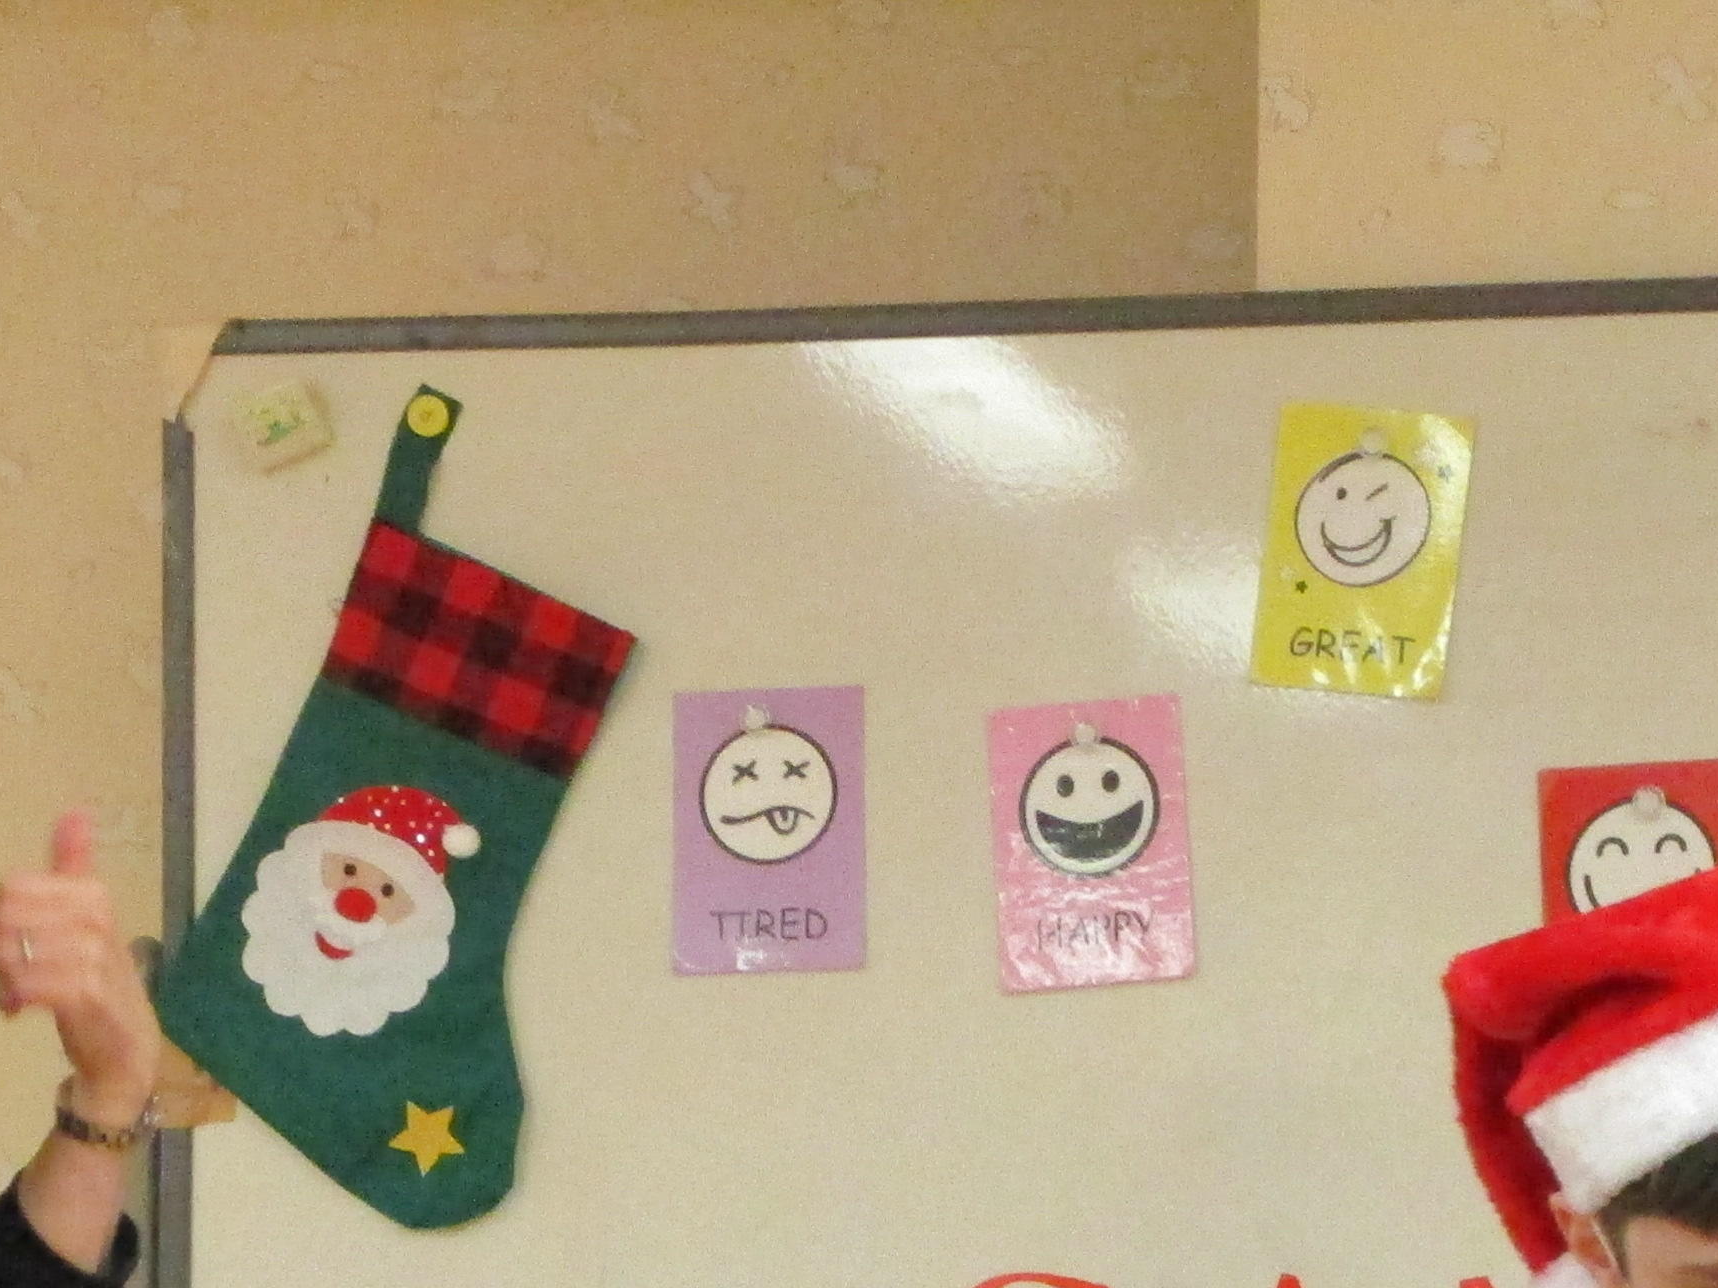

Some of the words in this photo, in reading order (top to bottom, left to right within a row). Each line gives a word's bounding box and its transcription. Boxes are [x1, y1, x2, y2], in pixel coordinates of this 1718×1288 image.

[1289, 626, 1416, 664] GREAT
[709, 907, 829, 941] TIRED
[1037, 908, 1152, 951] HAPPY
